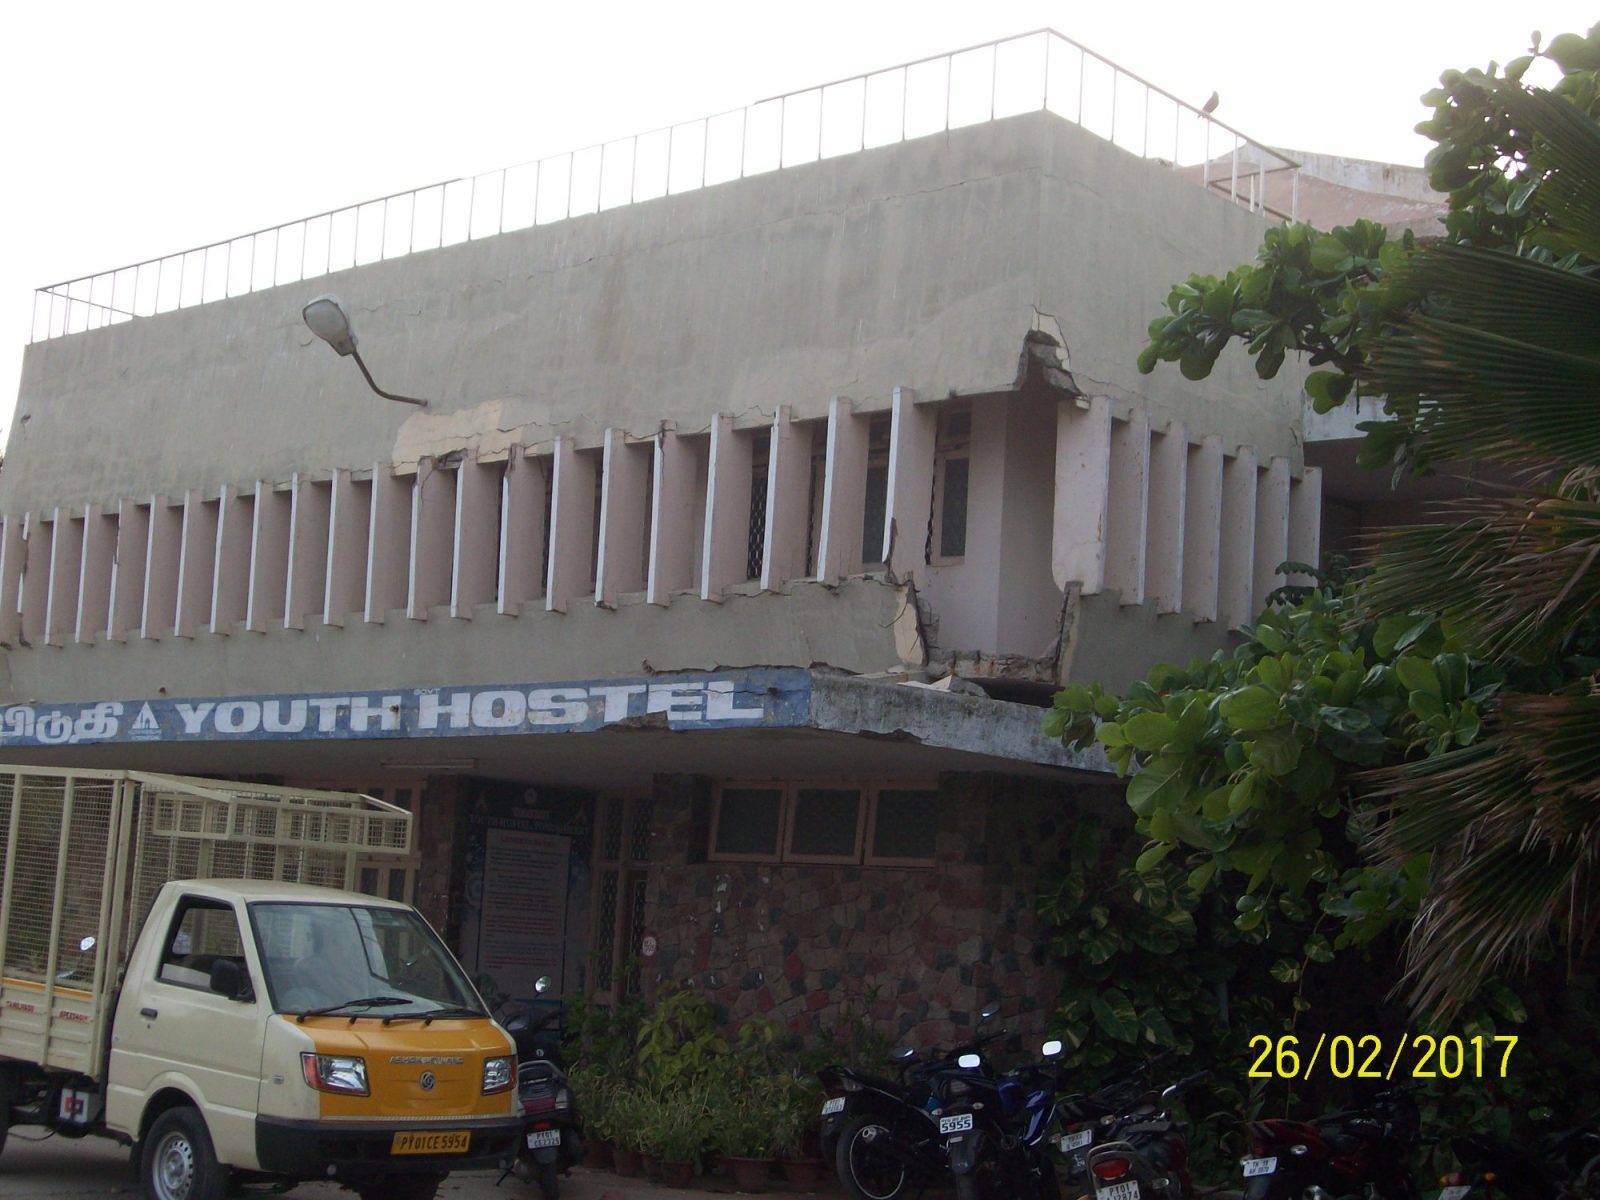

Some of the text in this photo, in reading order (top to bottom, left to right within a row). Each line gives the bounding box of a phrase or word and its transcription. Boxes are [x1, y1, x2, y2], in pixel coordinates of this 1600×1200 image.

[175, 680, 764, 734] YOUTH HOSTEL
[942, 1119, 971, 1132] 5955
